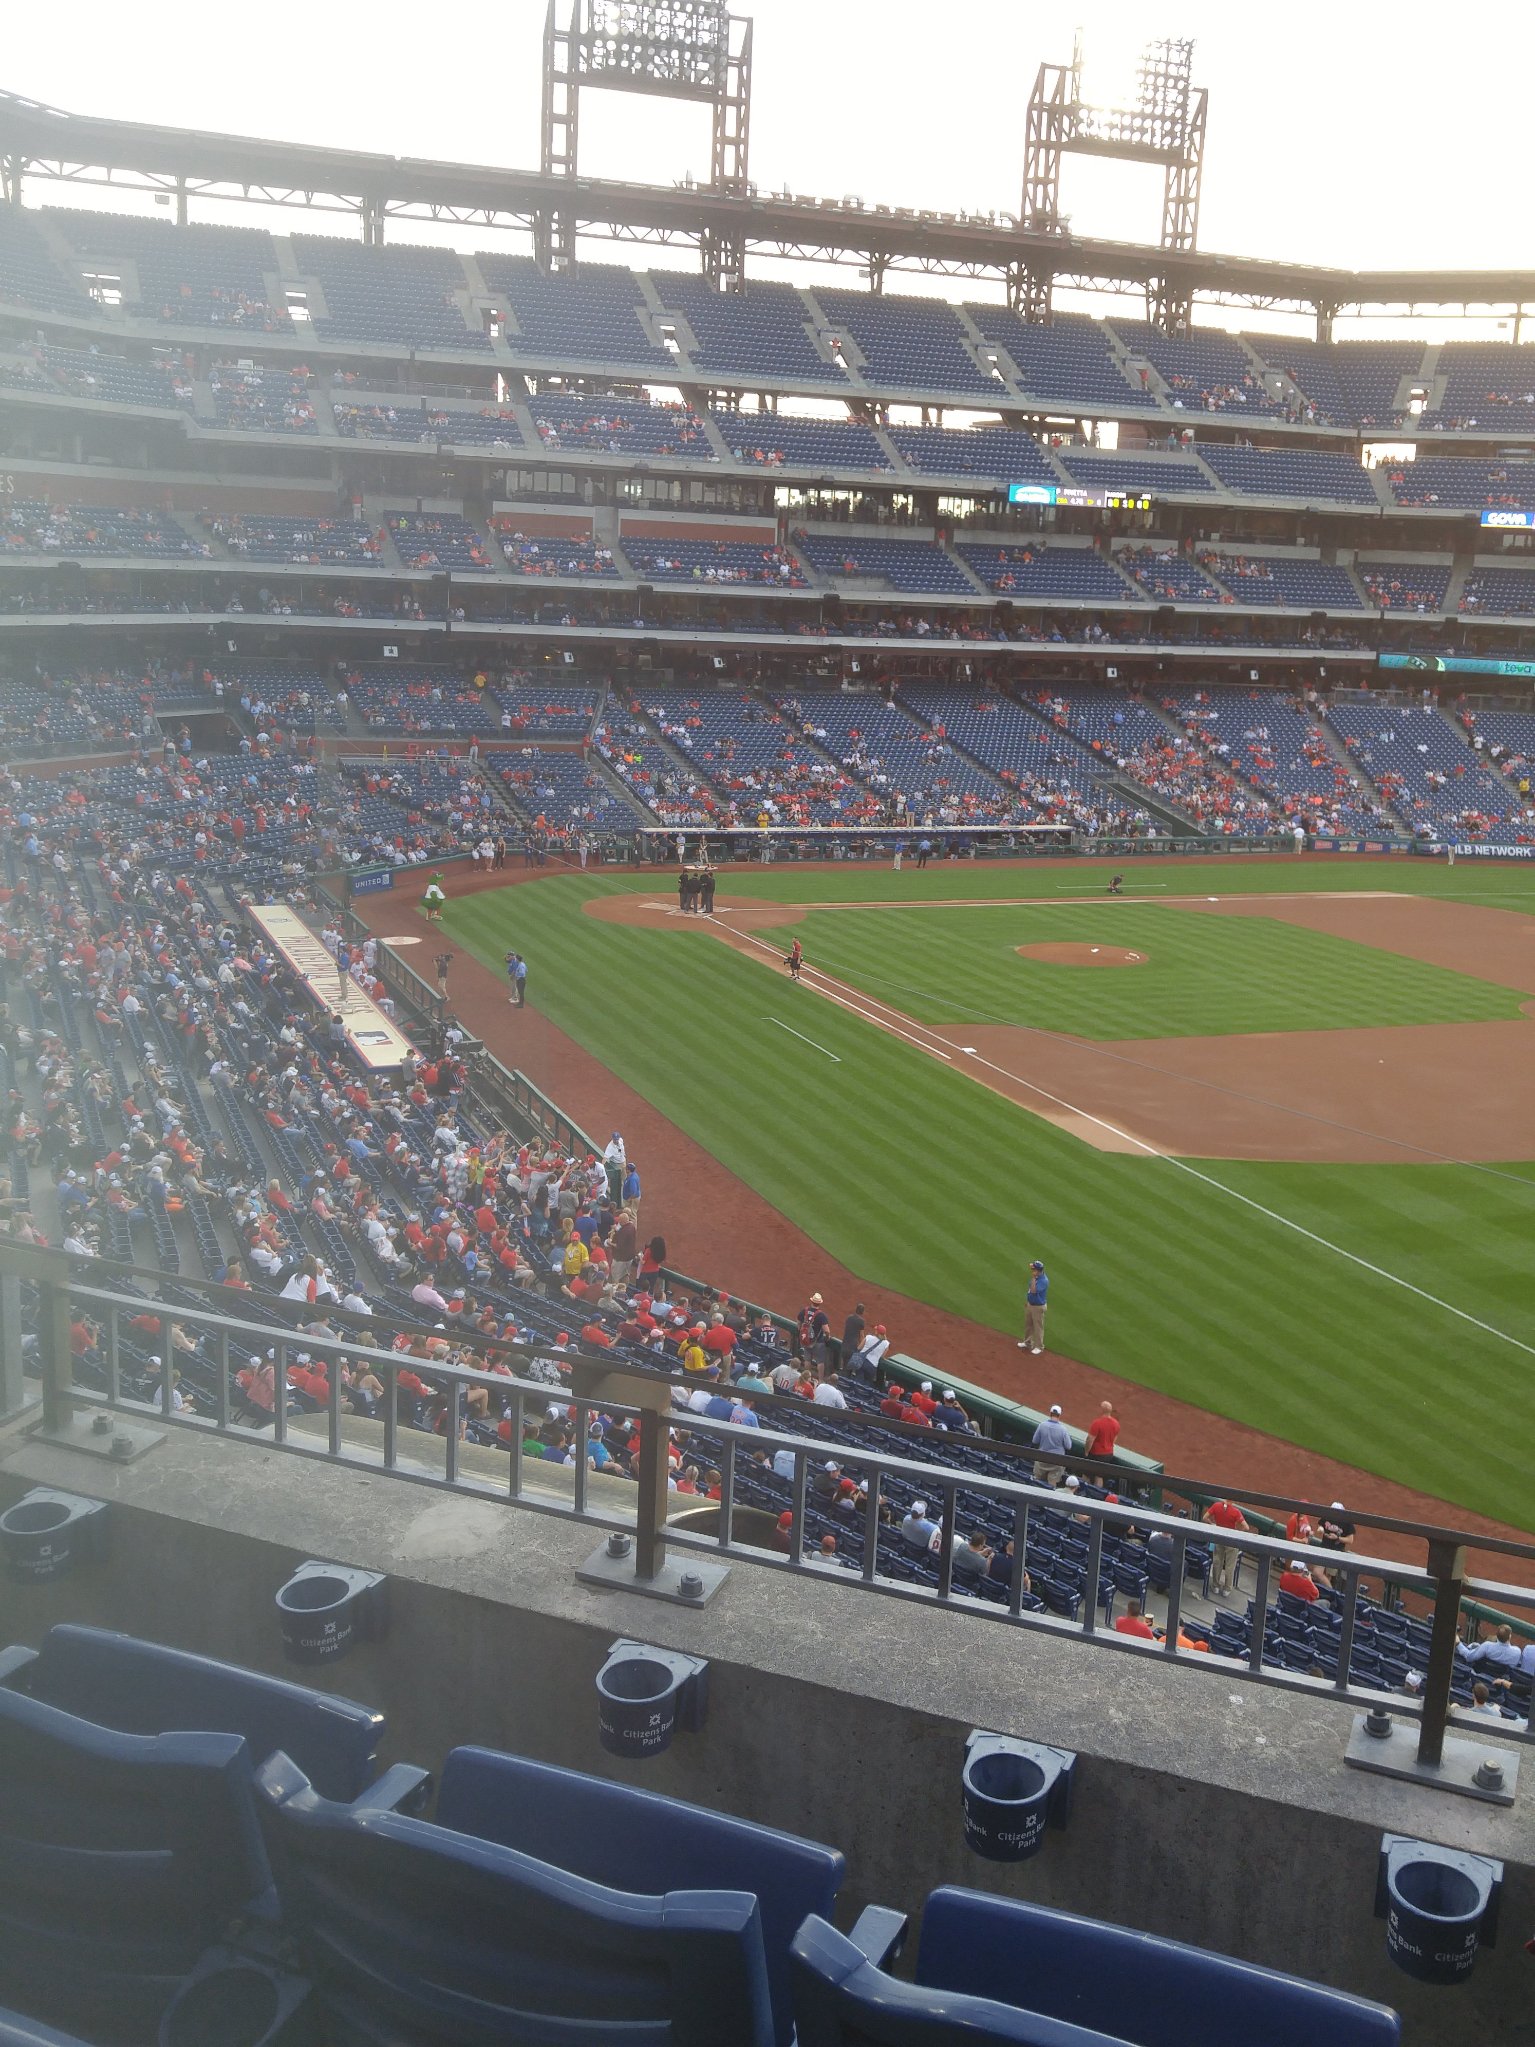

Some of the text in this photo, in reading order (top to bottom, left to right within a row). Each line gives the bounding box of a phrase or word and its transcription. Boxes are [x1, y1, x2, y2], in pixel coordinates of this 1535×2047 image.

[1504, 662, 1532, 674] teva
[1475, 845, 1532, 857] NETWORK
[355, 877, 381, 888] UNITED
[300, 1635, 337, 1647] Citizens
[319, 1642, 340, 1654] Park
[623, 1727, 660, 1738] Citizens
[642, 1735, 662, 1746] Park
[968, 1817, 988, 1837] Bank
[997, 1828, 1036, 1841] Citizens
[1017, 1836, 1037, 1849] Park
[1398, 1935, 1423, 1957] Bank
